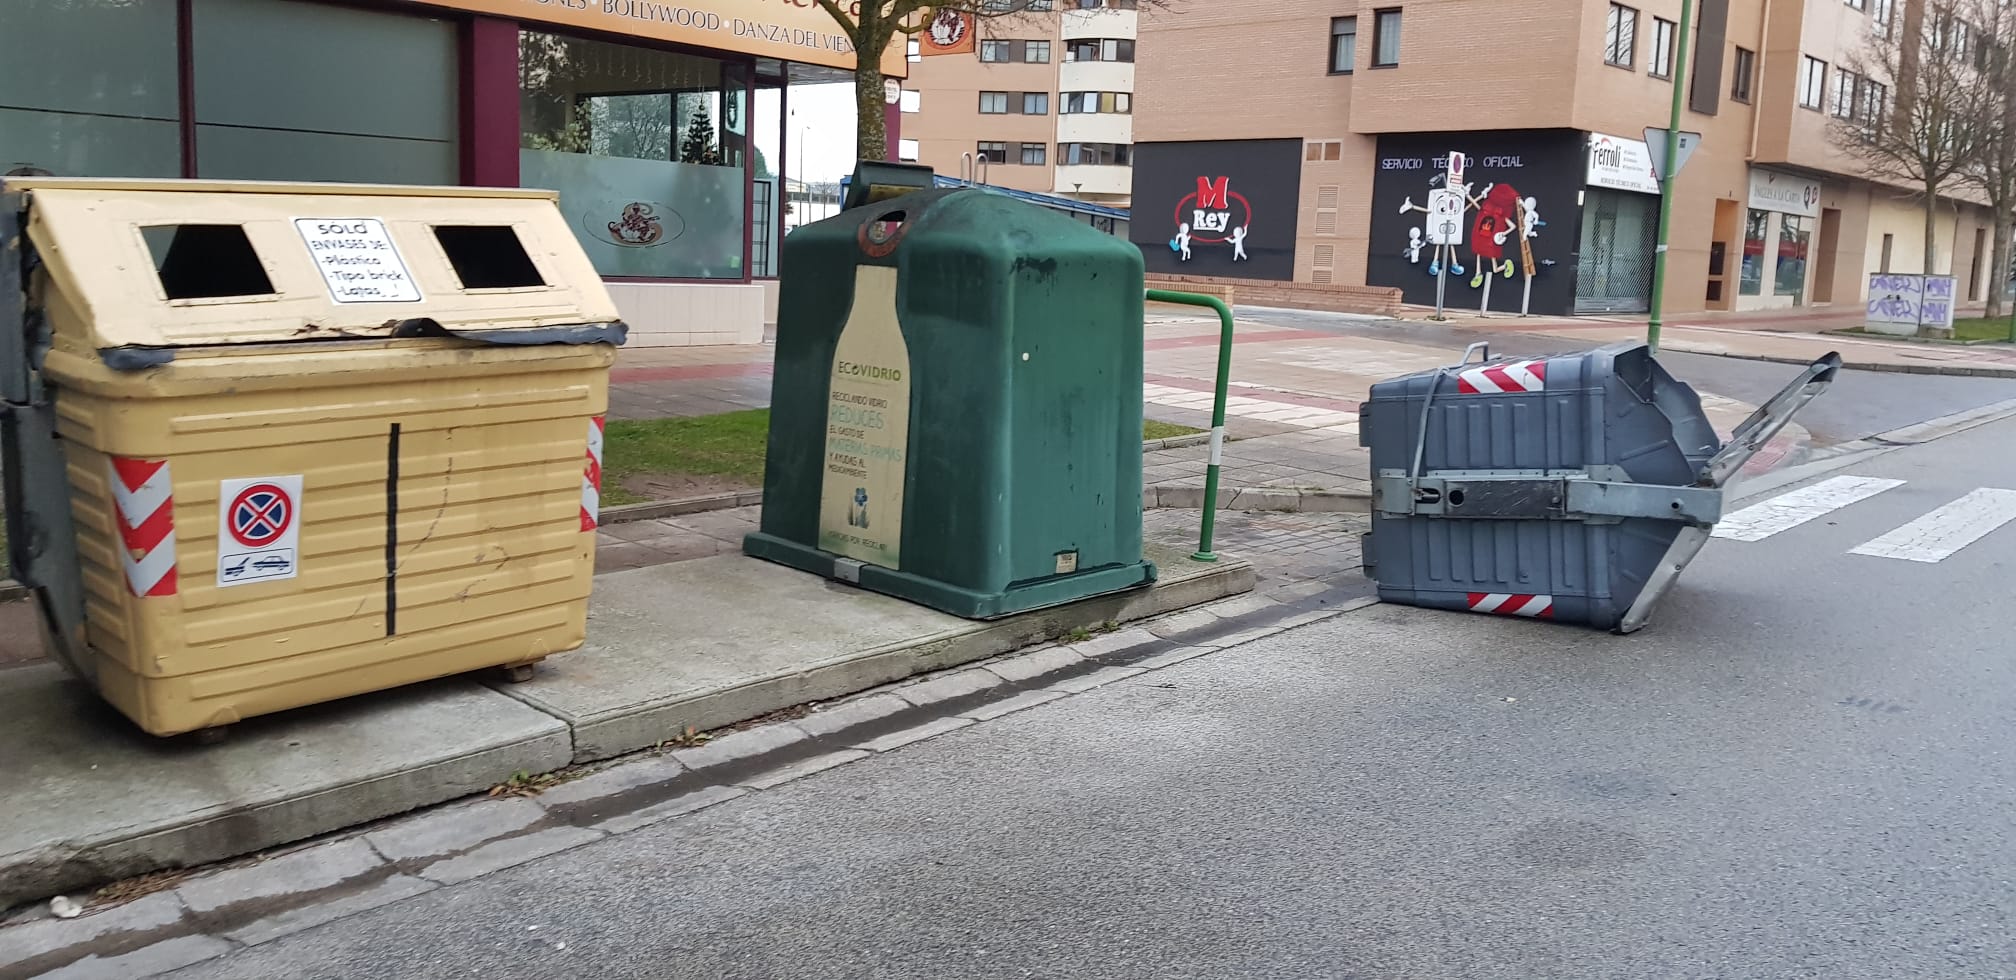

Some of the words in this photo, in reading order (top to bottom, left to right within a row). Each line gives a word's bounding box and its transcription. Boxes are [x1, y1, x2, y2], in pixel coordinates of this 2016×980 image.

[603, 0, 719, 31] BOLLYWOOD
[734, 18, 790, 44] DANZA
[793, 29, 820, 49] DEL
[823, 34, 857, 53] VIEN
[1382, 158, 1422, 169] SERVICIO
[1483, 156, 1524, 168] OFICIAL
[1593, 142, 1621, 169] Ferroli
[1196, 175, 1229, 209] M
[1193, 209, 1231, 233] Rey
[838, 361, 902, 382] ECOVIDRIO
